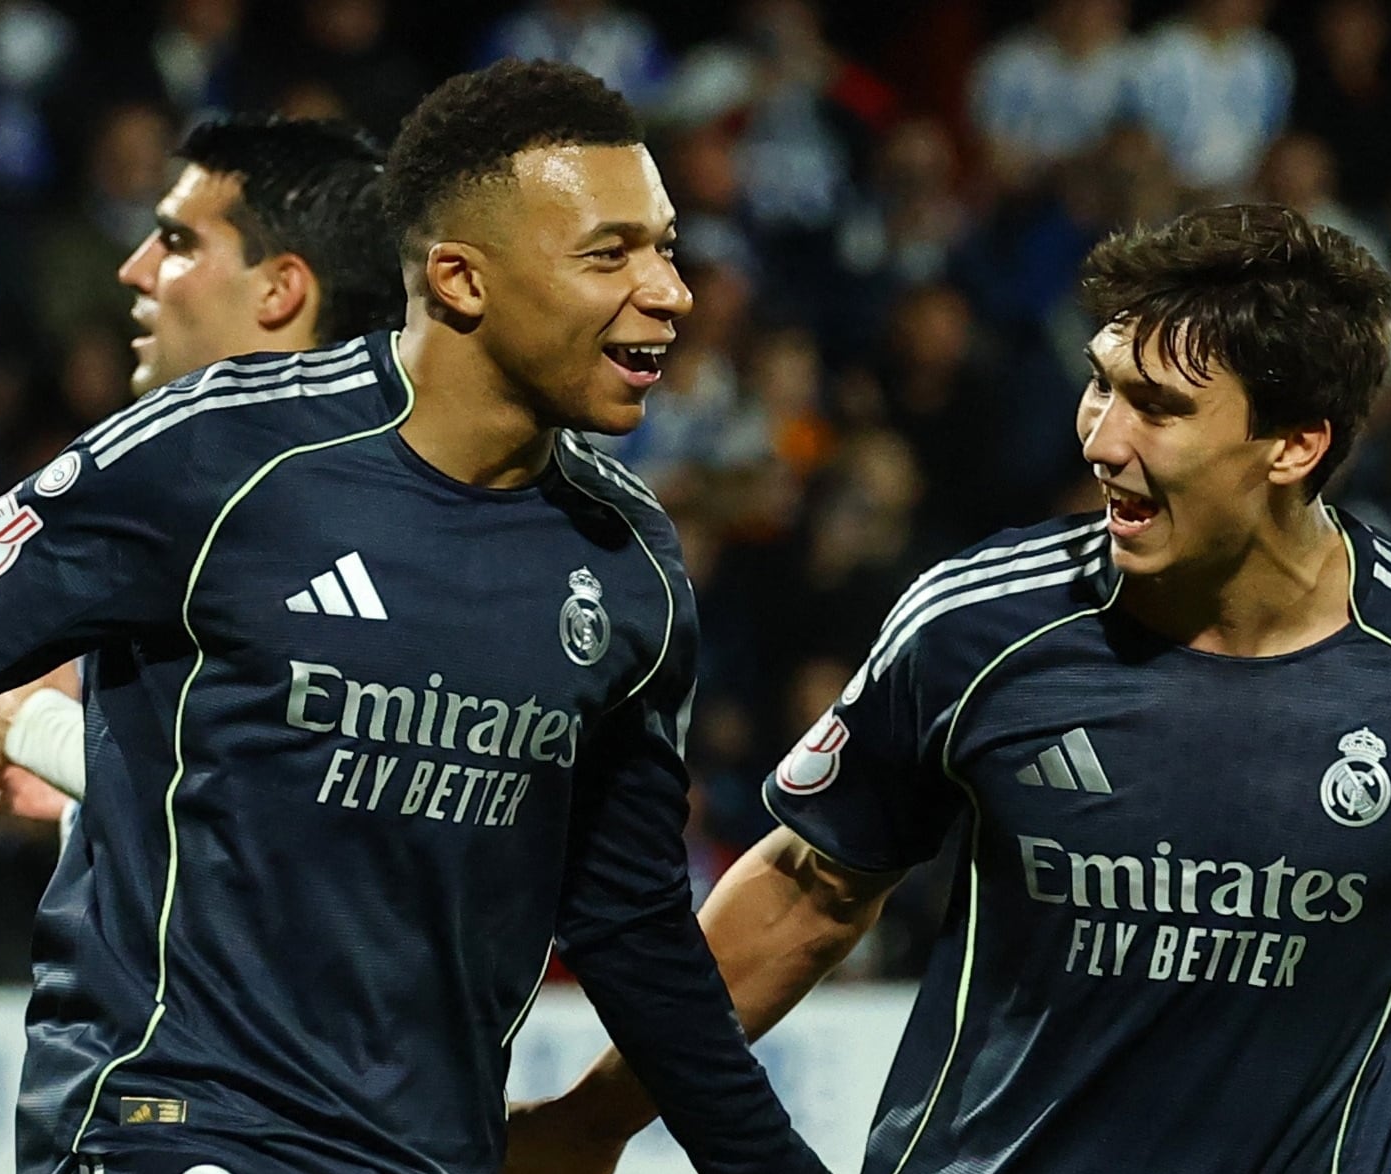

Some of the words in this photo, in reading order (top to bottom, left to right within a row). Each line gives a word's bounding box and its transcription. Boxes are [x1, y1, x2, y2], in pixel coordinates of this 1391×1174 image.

[286, 660, 583, 768] Emirates
[316, 749, 400, 811] FLY
[400, 761, 531, 826] BETTER
[1018, 834, 1367, 923] Emirates
[1065, 919, 1138, 976] FLY
[1148, 925, 1307, 988] BETTER
